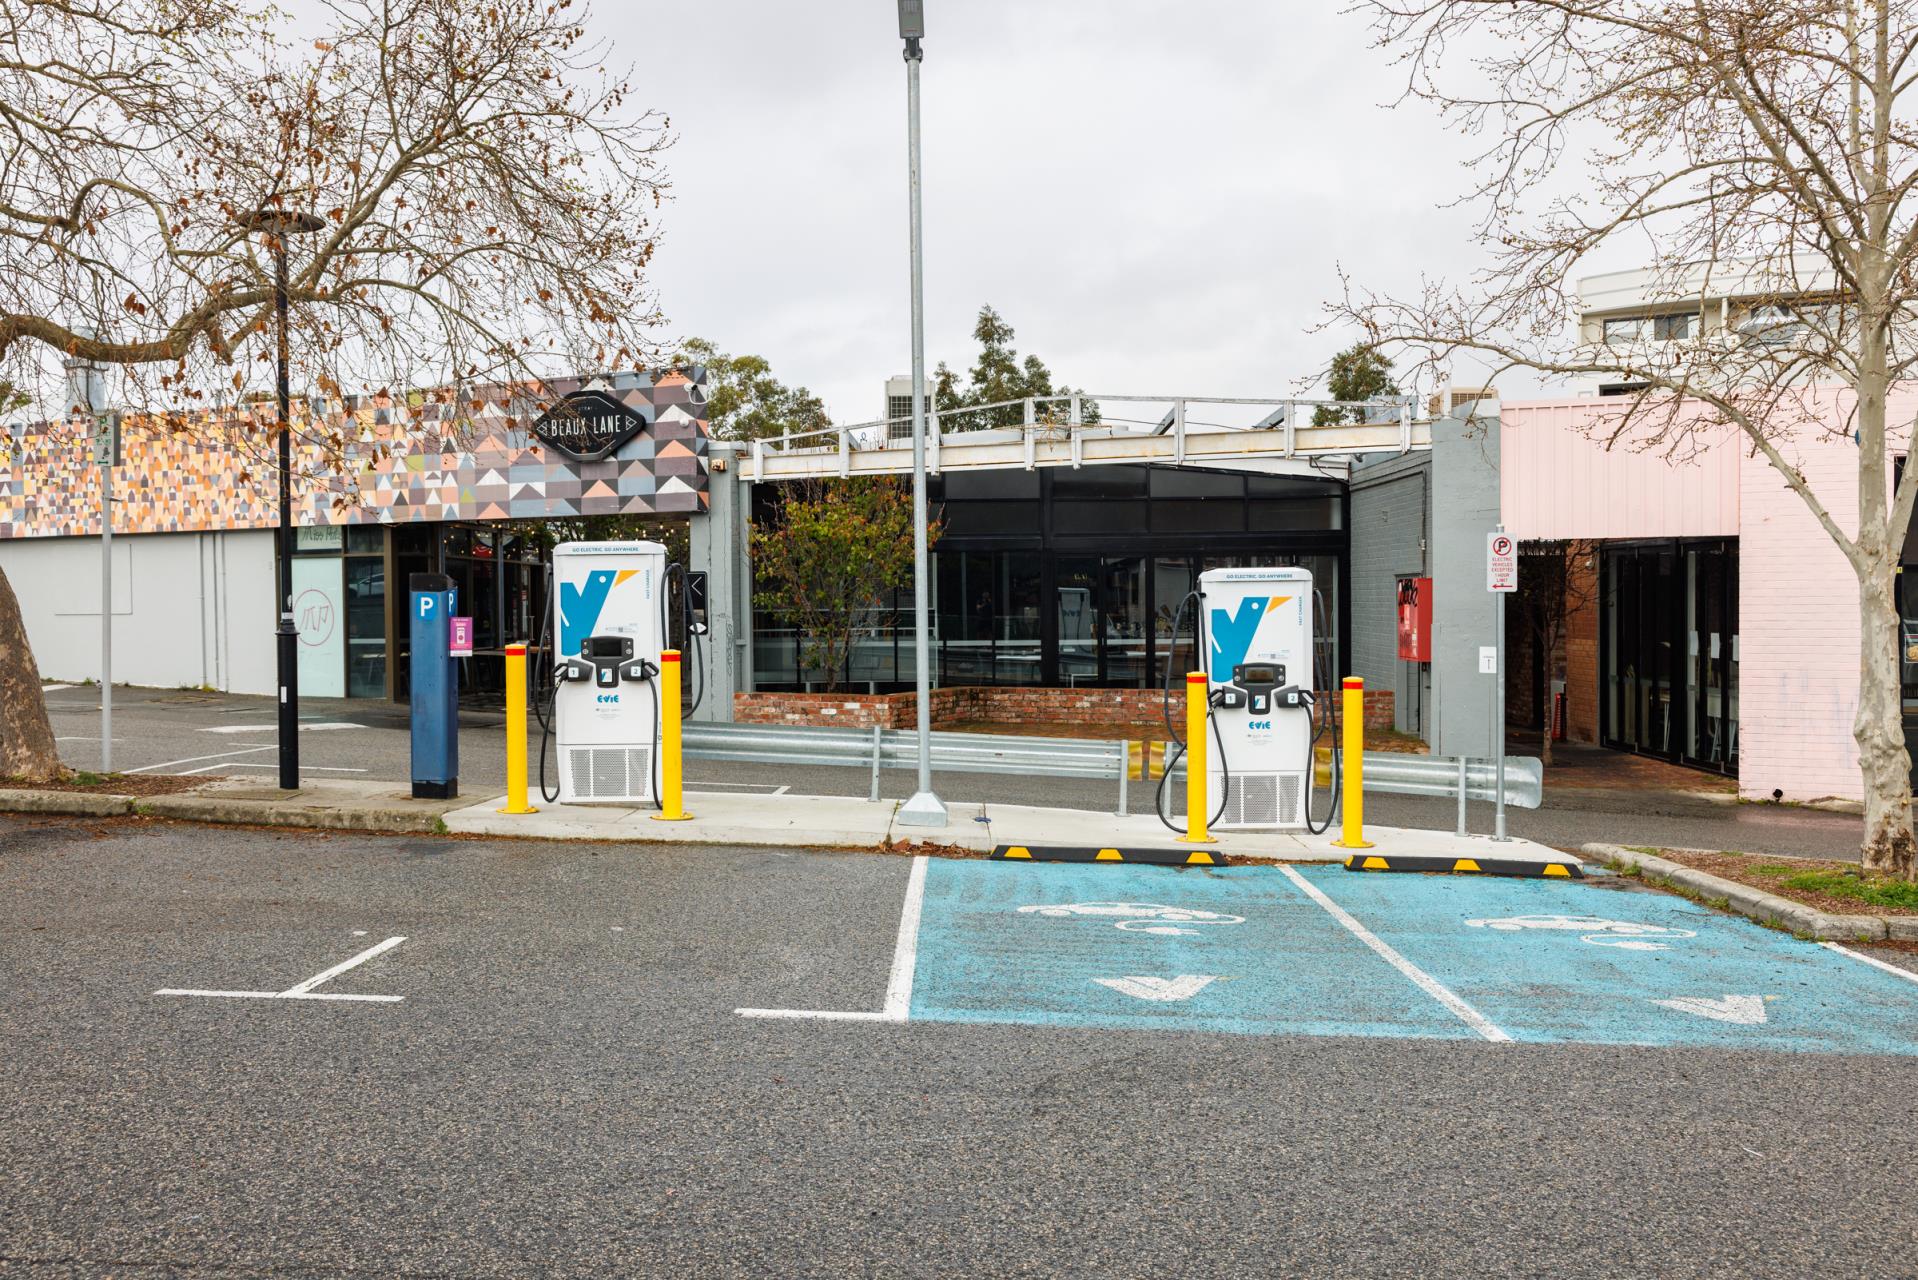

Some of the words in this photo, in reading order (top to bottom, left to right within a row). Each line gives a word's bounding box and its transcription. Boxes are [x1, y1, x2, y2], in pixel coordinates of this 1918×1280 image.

[551, 418, 587, 437] BEAUX
[593, 415, 620, 434] LANE
[420, 596, 434, 617] P
[448, 592, 454, 613] P
